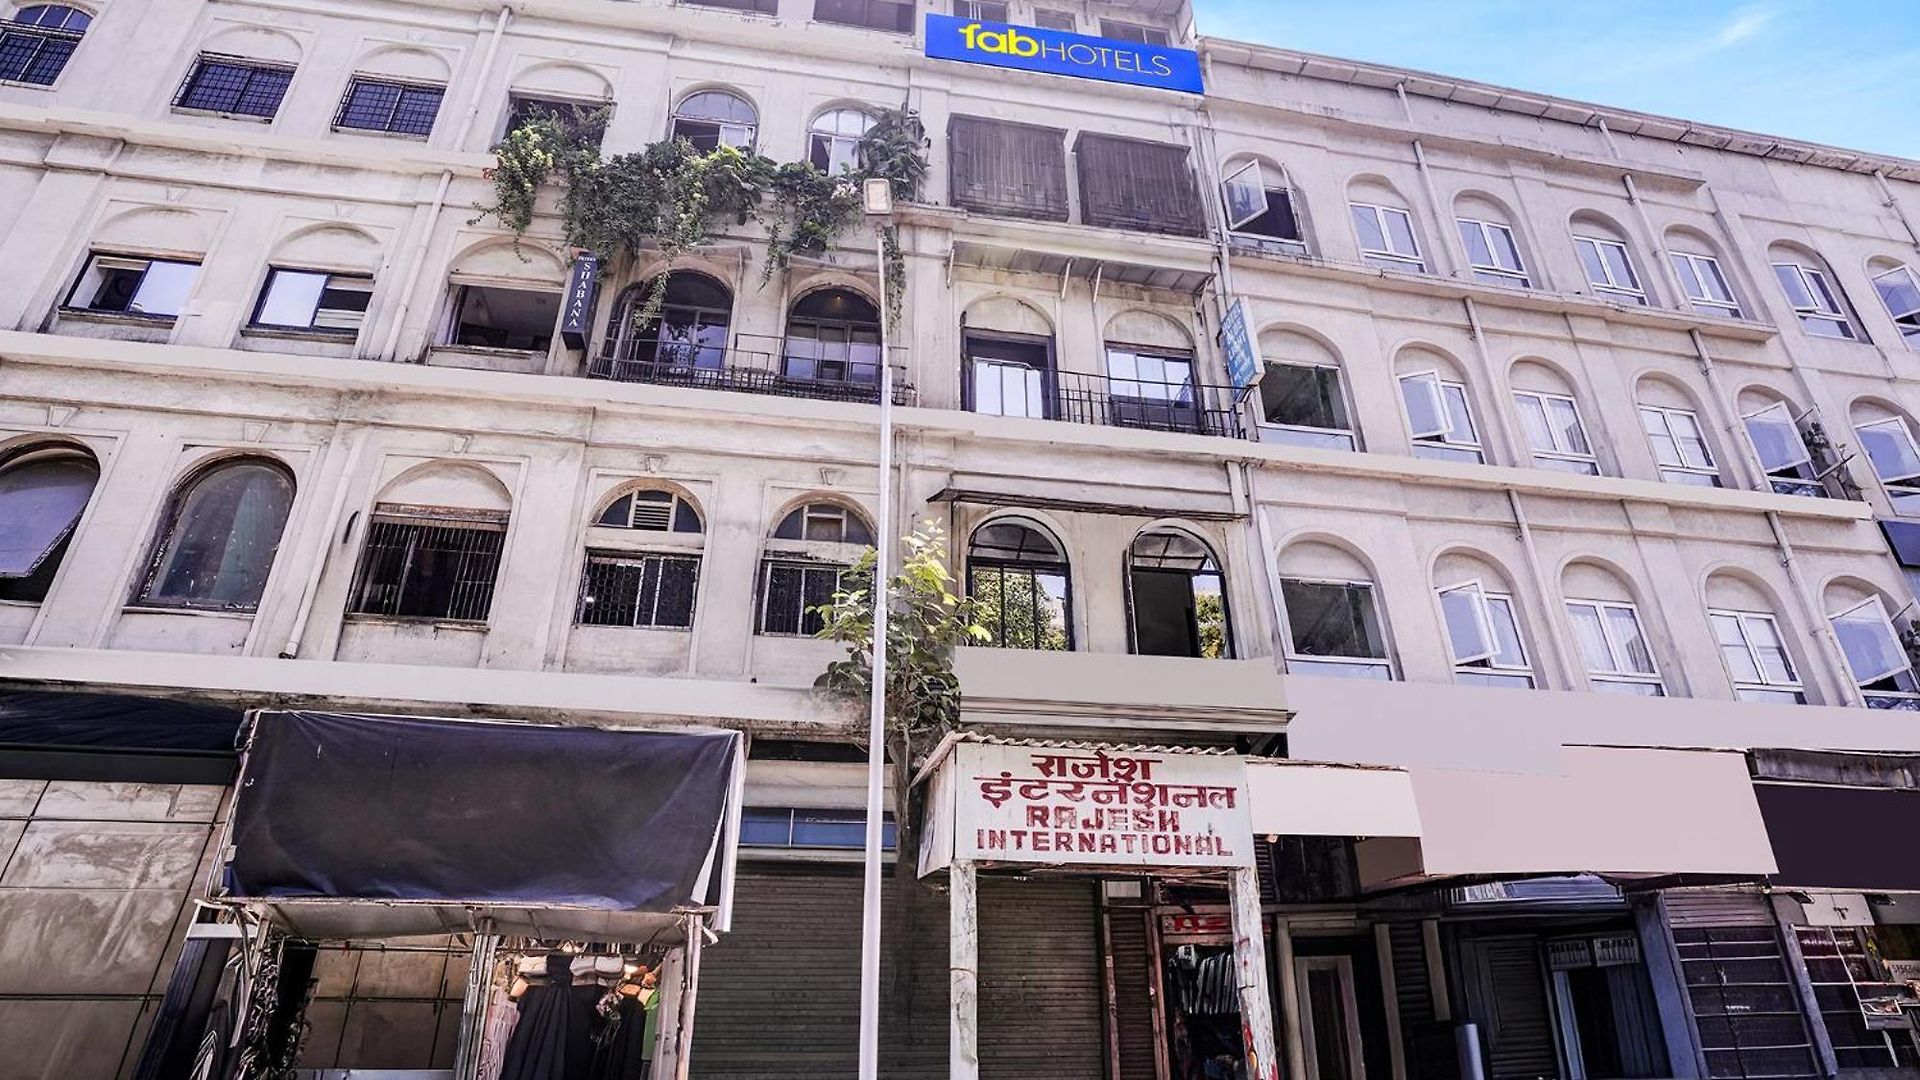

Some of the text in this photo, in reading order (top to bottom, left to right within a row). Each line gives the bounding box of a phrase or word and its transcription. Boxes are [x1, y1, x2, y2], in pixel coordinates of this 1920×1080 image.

[569, 262, 592, 327] SHABANA
[1031, 751, 1162, 782] राजेश
[1026, 805, 1180, 833] RAJESH
[976, 829, 1233, 857] INTERNATIONAL
